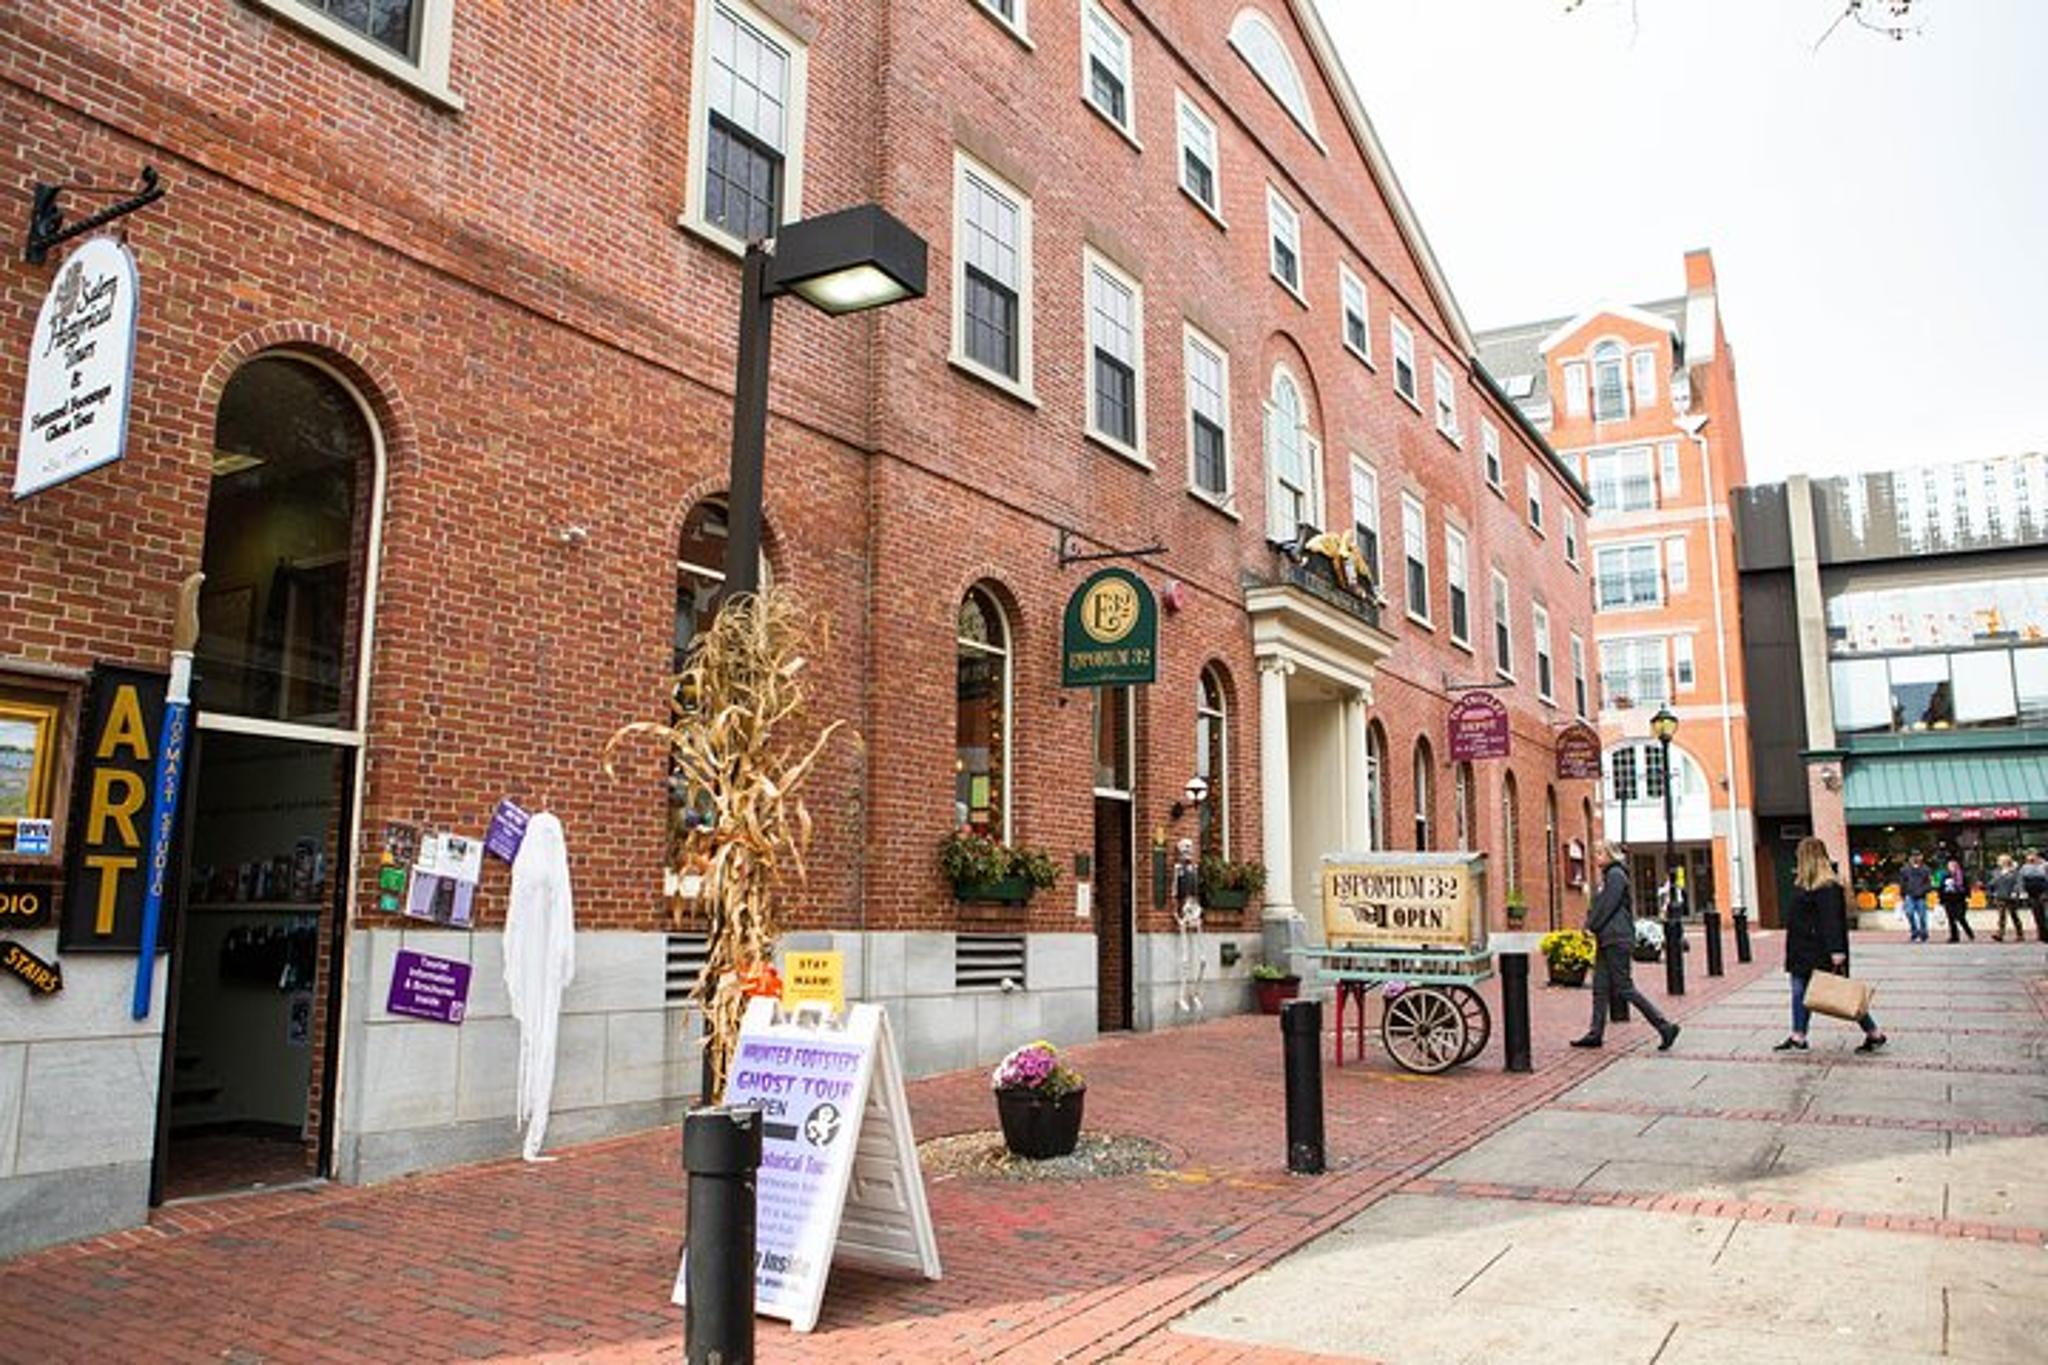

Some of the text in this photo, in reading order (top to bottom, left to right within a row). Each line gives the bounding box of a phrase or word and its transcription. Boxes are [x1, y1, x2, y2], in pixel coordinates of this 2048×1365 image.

[84, 684, 151, 934] ART
[1426, 876, 1458, 900] 32
[1392, 907, 1443, 928] OPEN
[5, 946, 59, 991] STAIRS
[737, 1070, 854, 1100] GHOST TOUR
